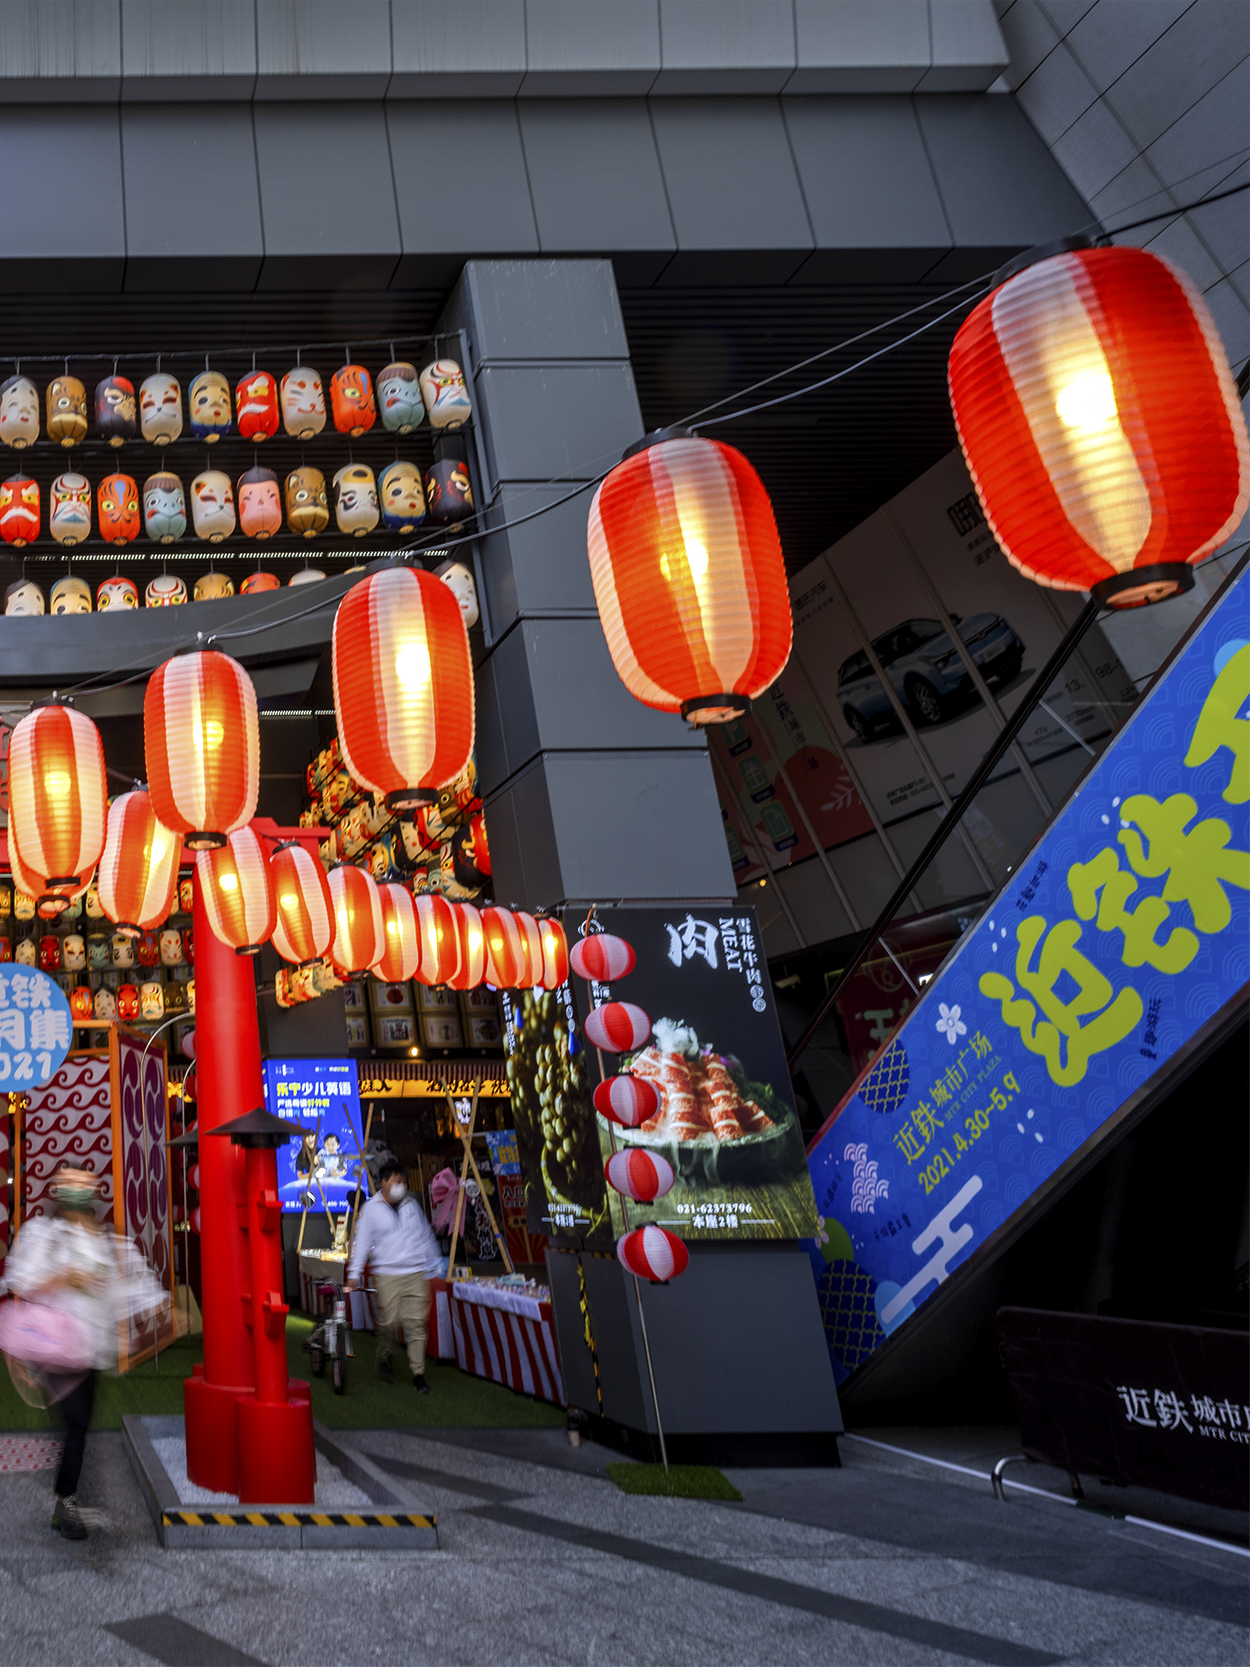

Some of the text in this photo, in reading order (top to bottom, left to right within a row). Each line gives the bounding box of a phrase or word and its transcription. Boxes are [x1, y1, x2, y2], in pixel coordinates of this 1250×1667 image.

[663, 912, 720, 970] 肉
[719, 917, 743, 974] MEAT
[976, 1055, 1002, 1084] PLAZA
[276, 1081, 352, 1097] 乐宁少儿英语
[1199, 1424, 1229, 1442] MTR
